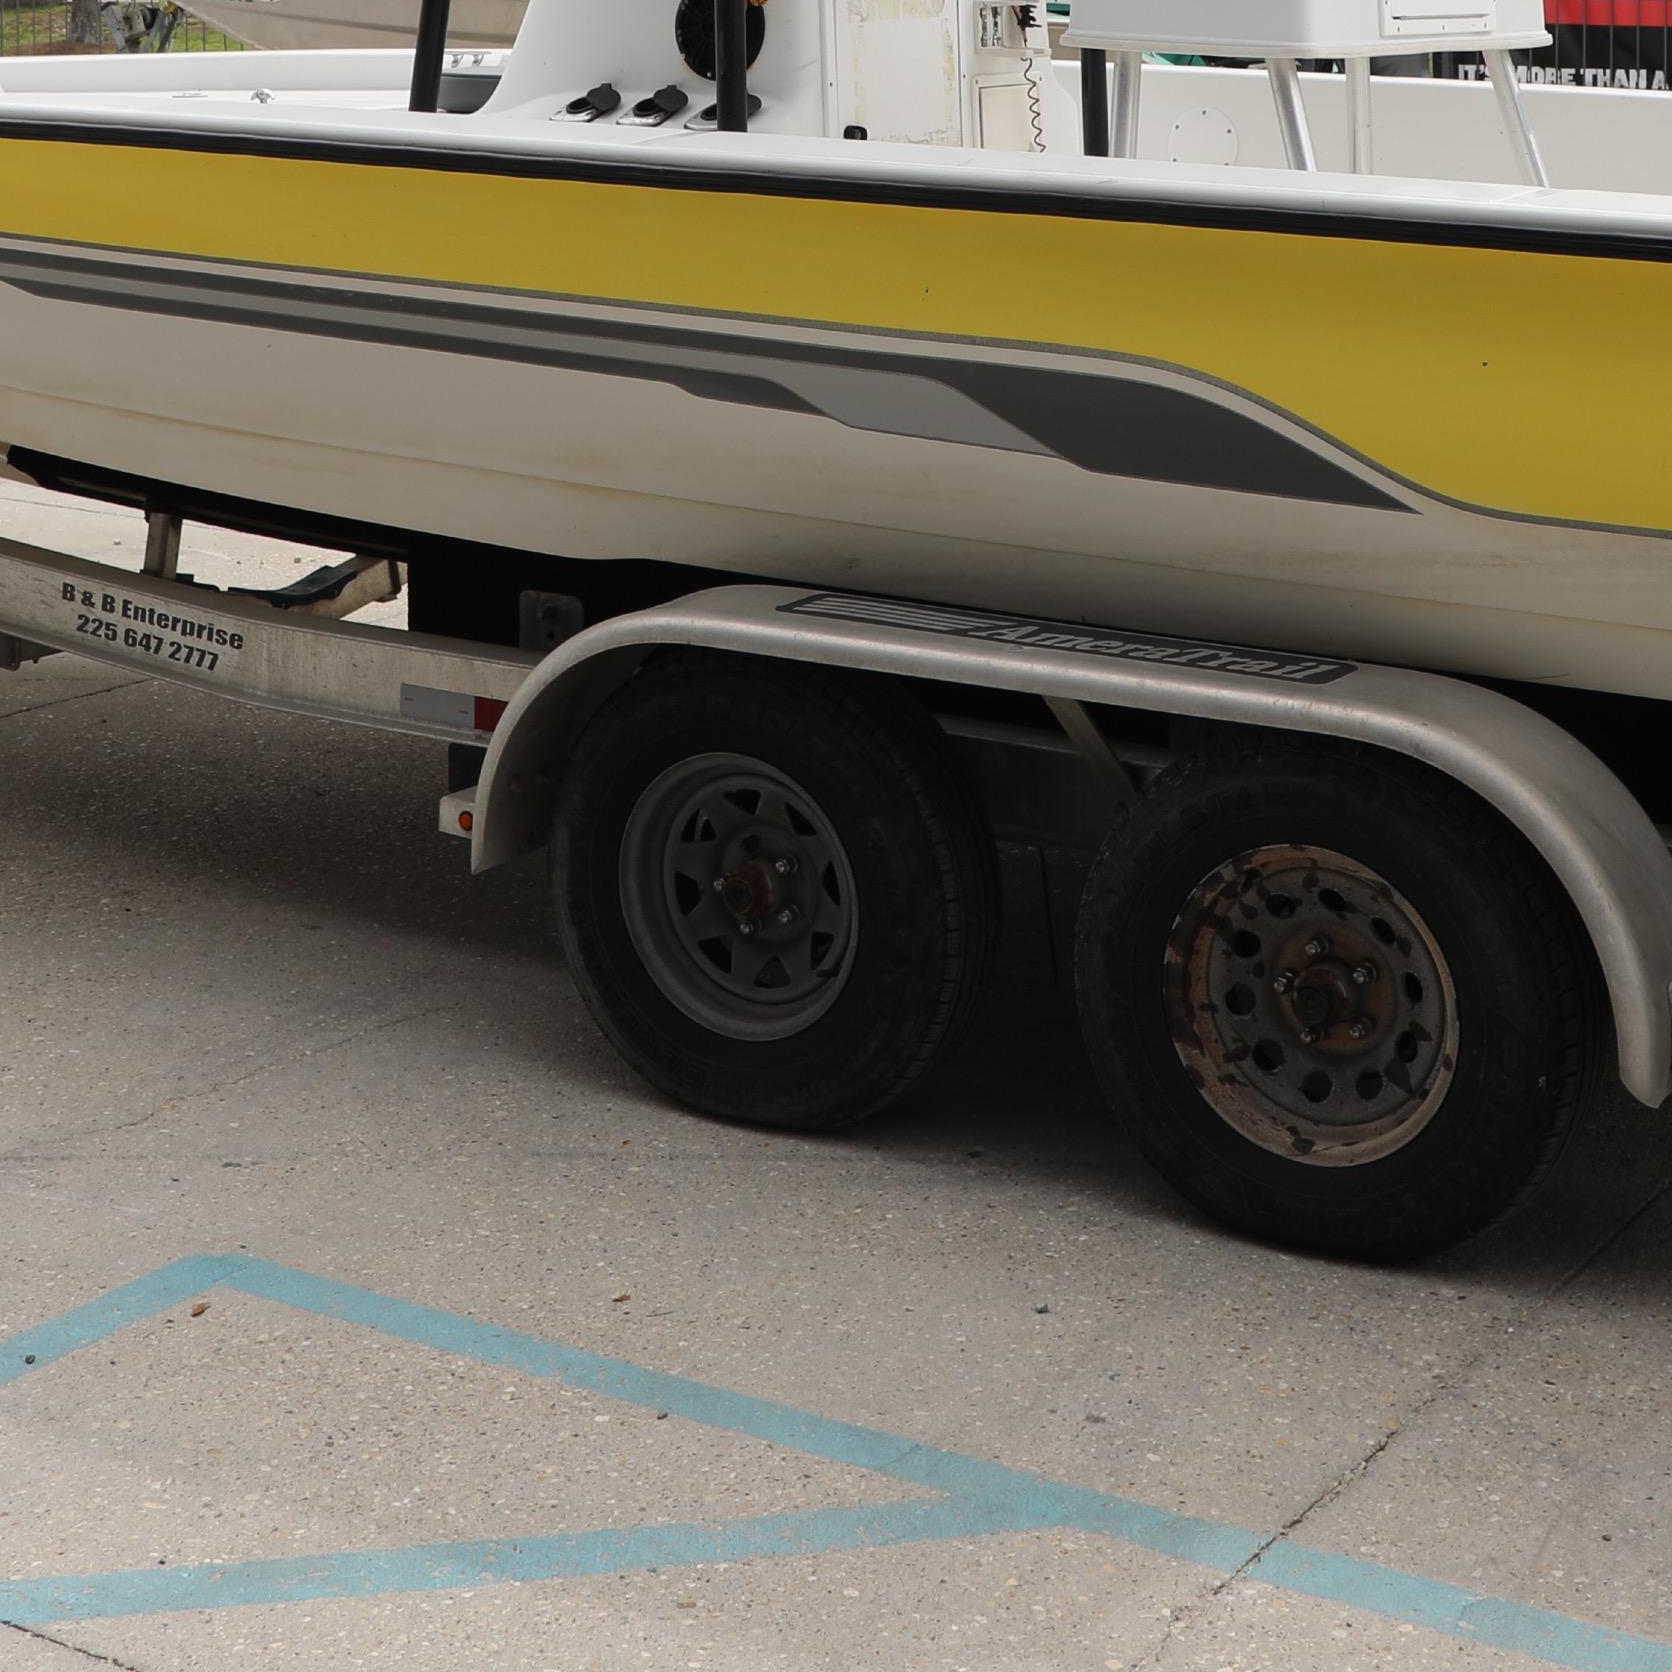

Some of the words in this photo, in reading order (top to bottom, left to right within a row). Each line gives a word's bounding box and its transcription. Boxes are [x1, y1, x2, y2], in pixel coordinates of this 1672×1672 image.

[1580, 67, 1648, 89] THAN
[1651, 70, 1670, 90] A
[61, 581, 76, 603] B
[80, 590, 96, 610] &
[101, 593, 116, 614] B
[120, 598, 245, 650] Enterprise
[75, 614, 118, 642] 225
[123, 628, 164, 656] 647
[168, 640, 220, 672] 2777
[968, 625, 1337, 681] AmeraTrail
